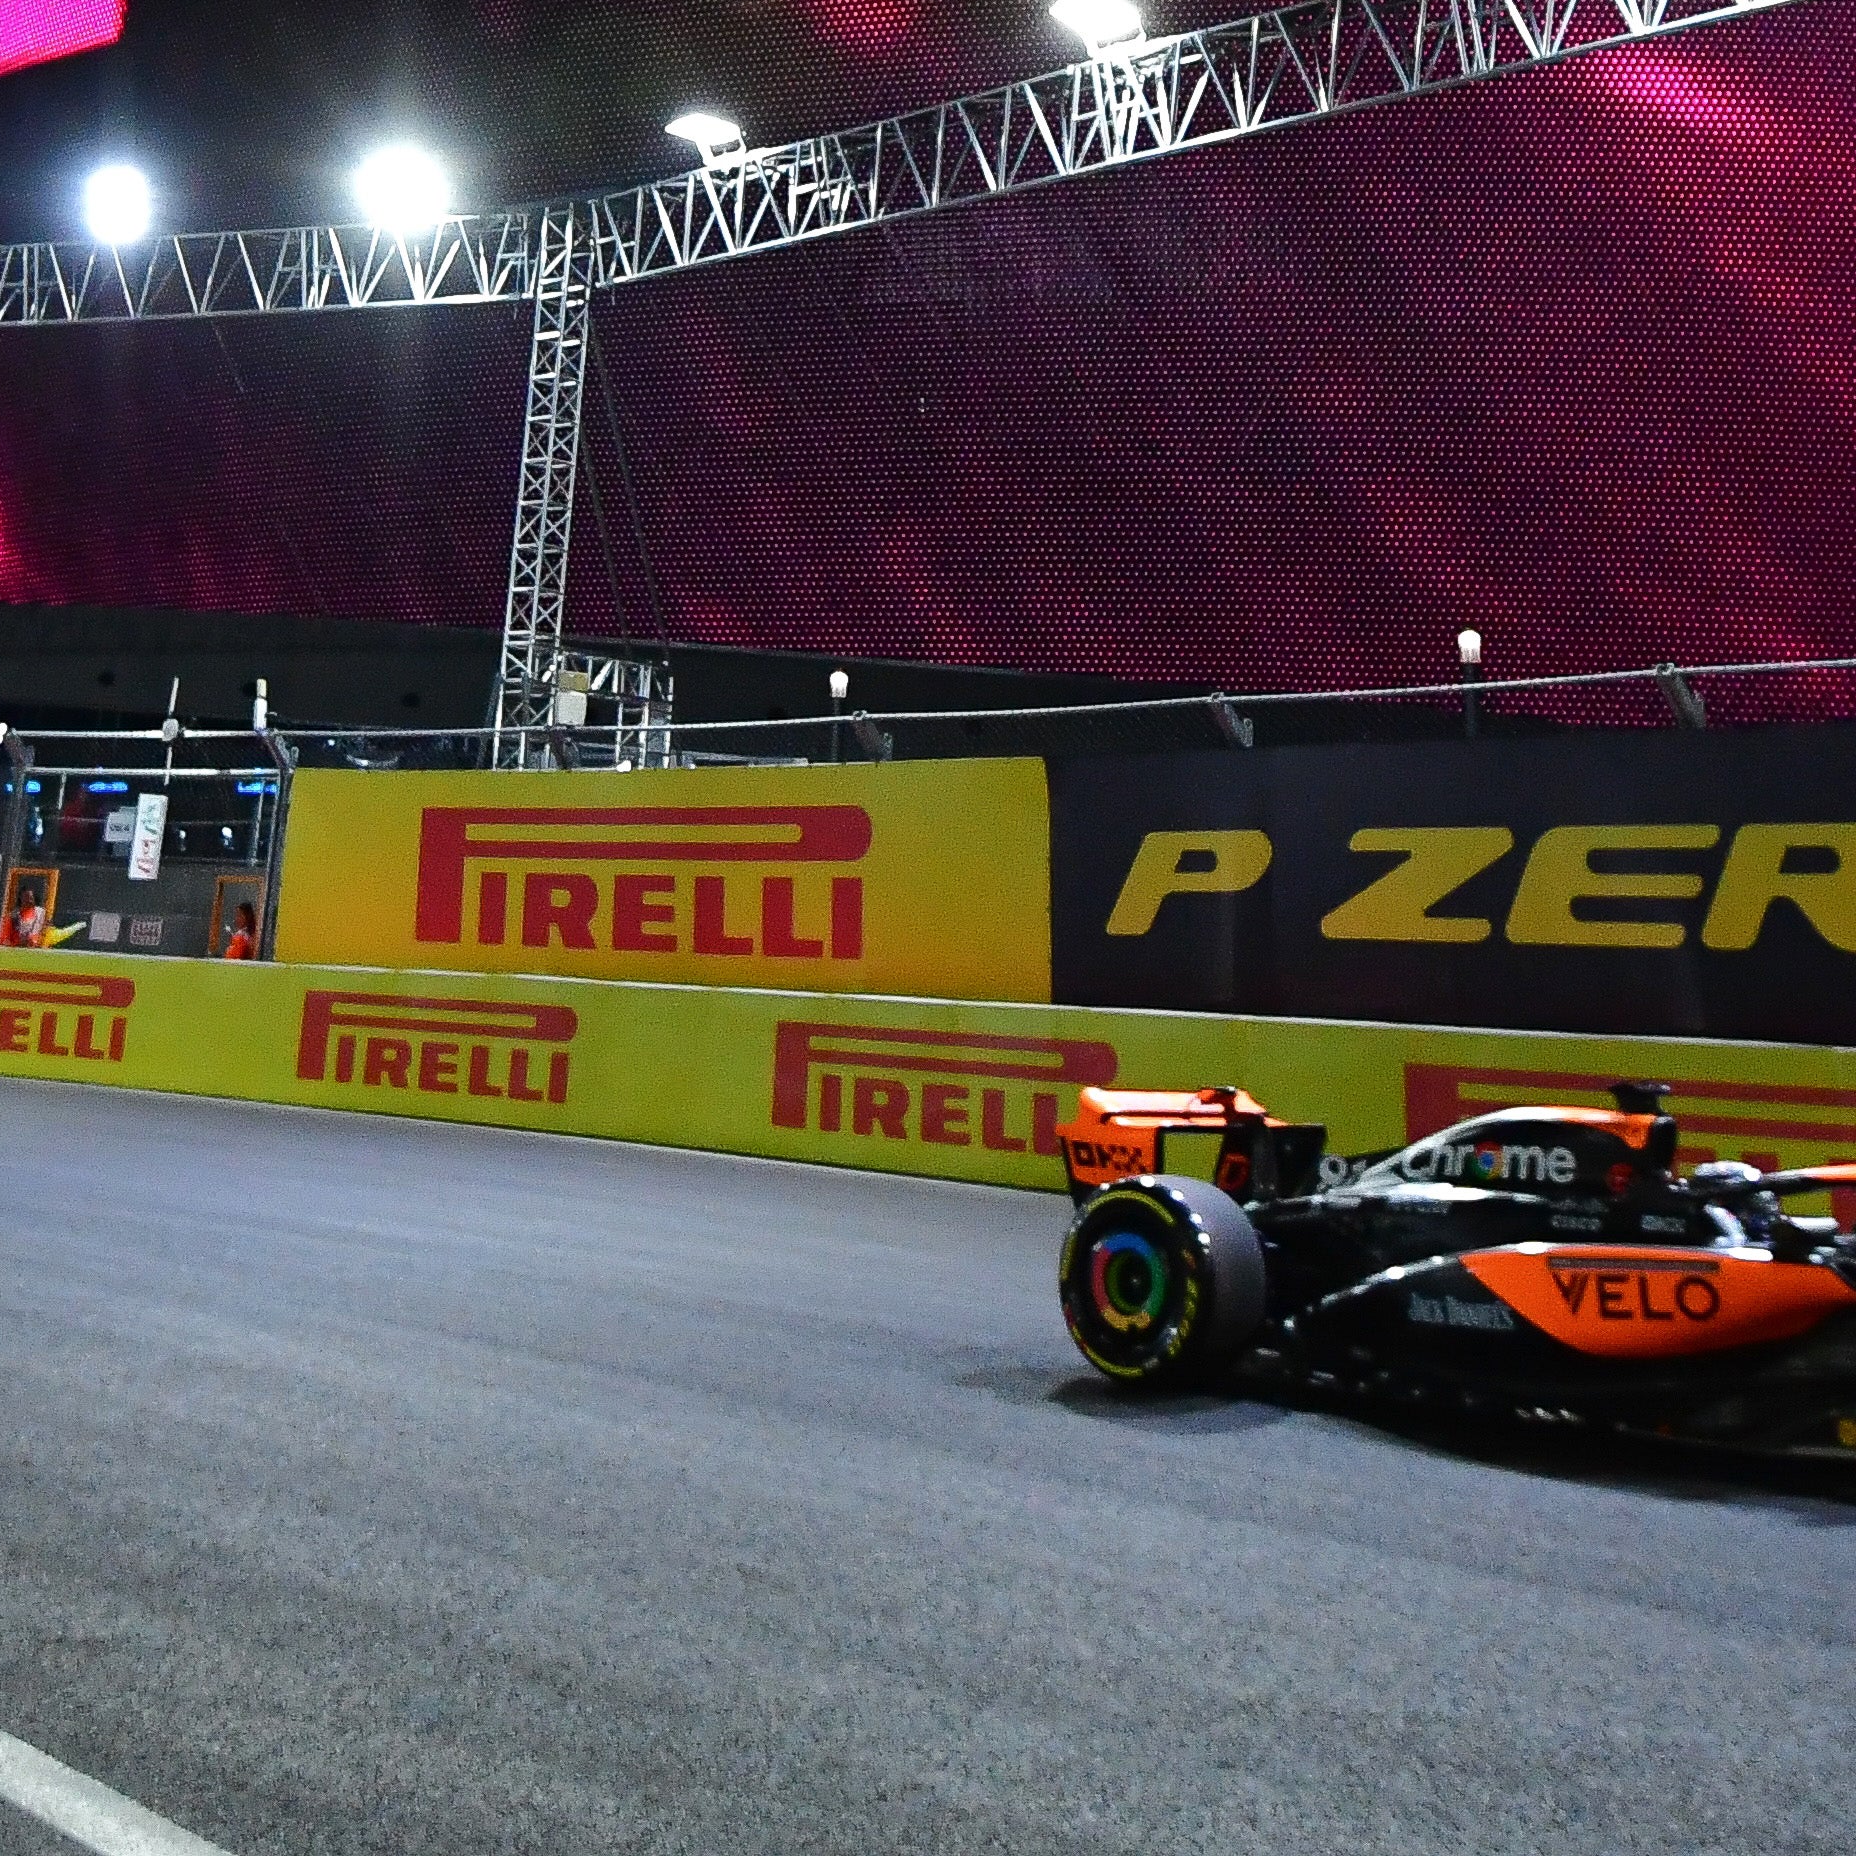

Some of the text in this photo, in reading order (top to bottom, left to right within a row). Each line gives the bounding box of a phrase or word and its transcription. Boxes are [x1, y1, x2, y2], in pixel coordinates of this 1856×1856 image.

[414, 805, 873, 962] PIRELLI
[1105, 829, 1274, 937] P
[297, 990, 578, 1104] PIRELLI
[1551, 1271, 1721, 1322] VELO
